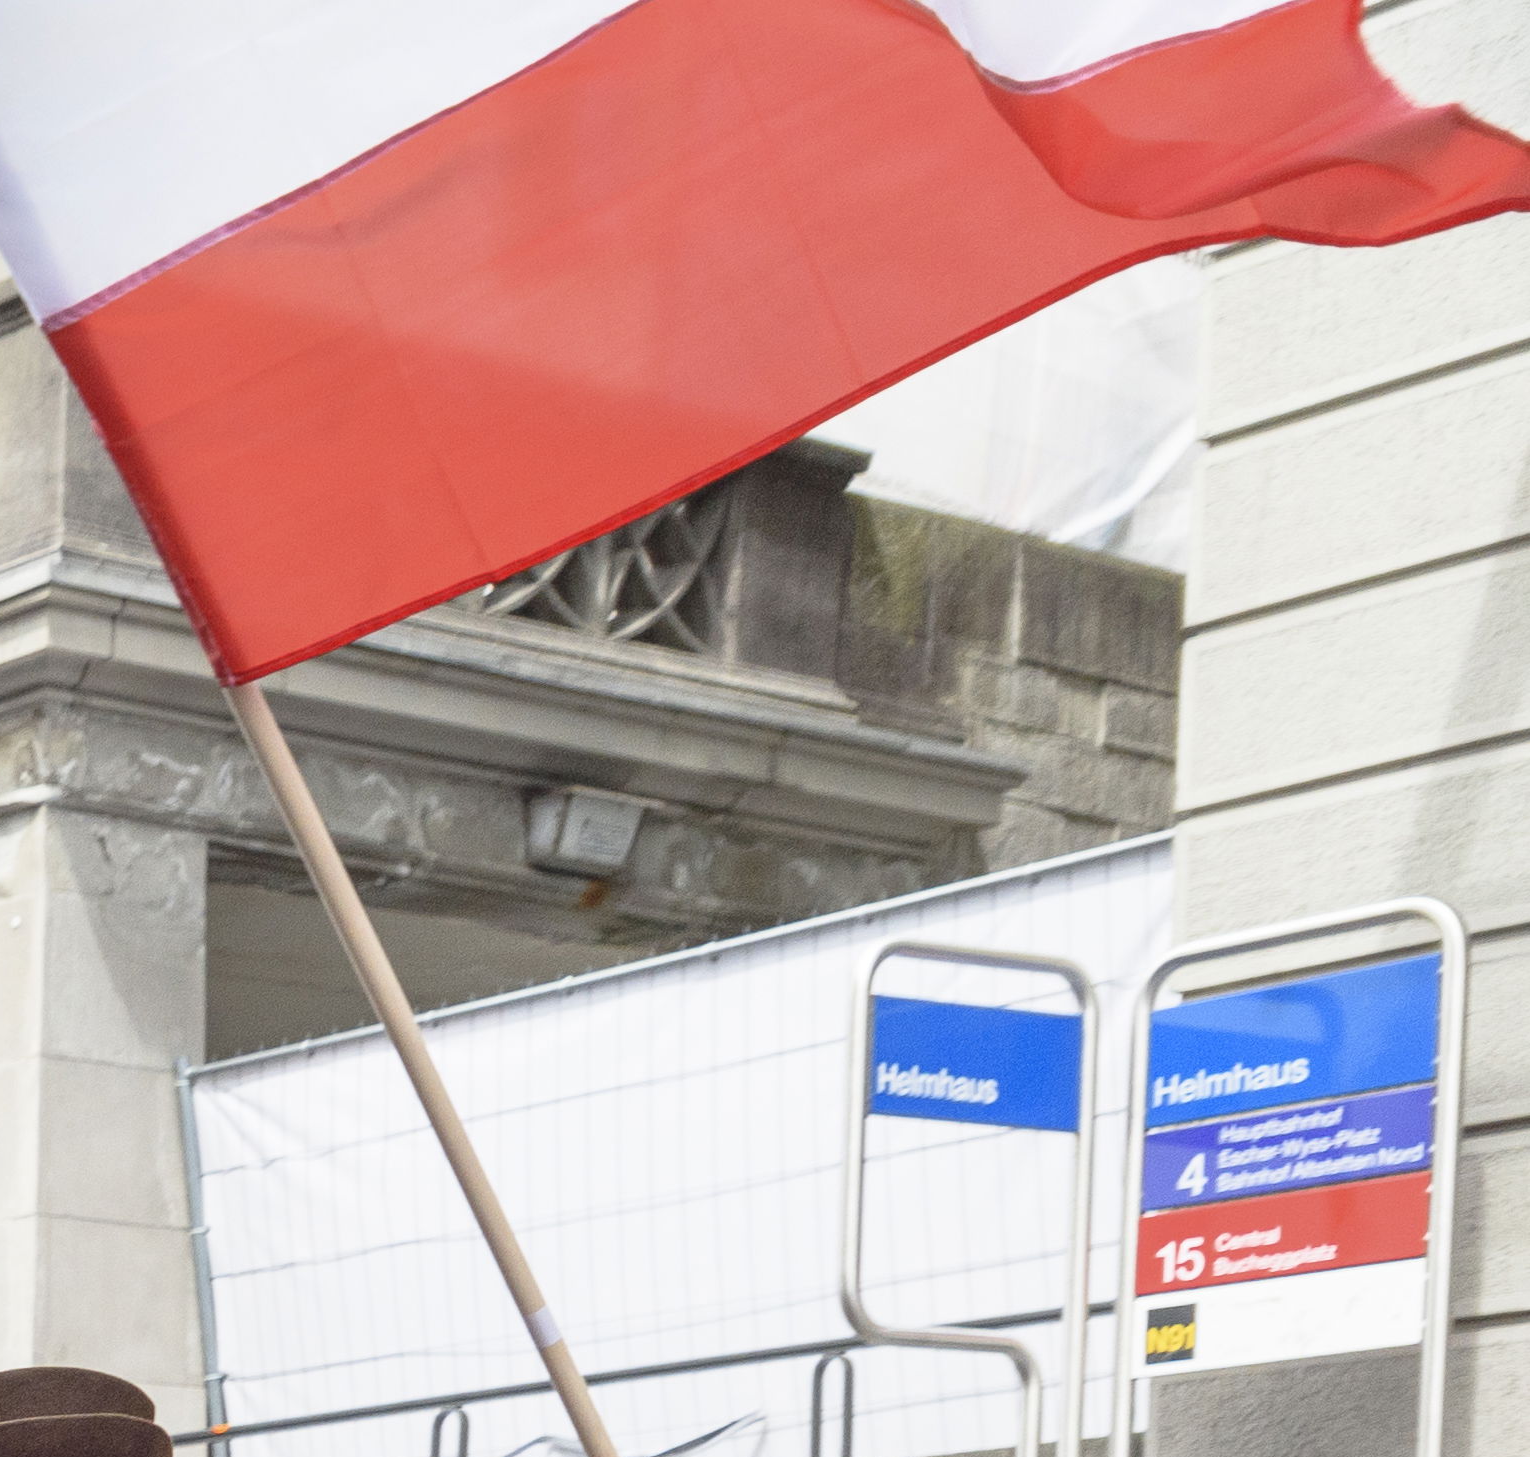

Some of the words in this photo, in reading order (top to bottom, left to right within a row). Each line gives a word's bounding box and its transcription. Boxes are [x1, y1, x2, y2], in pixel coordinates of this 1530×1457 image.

[876, 1062, 999, 1104] Helmhaus
[1152, 1058, 1310, 1109] Helmhaus
[1218, 1106, 1345, 1144] Hauptbahnhof
[1175, 1153, 1208, 1197] 4
[1215, 1163, 1292, 1193] Bahnhof
[1377, 1141, 1426, 1166] Nord
[1155, 1236, 1206, 1284] 15
[1214, 1225, 1282, 1253] Central
[1212, 1244, 1339, 1277] Bucheggplatz
[1146, 1321, 1196, 1355] N91
